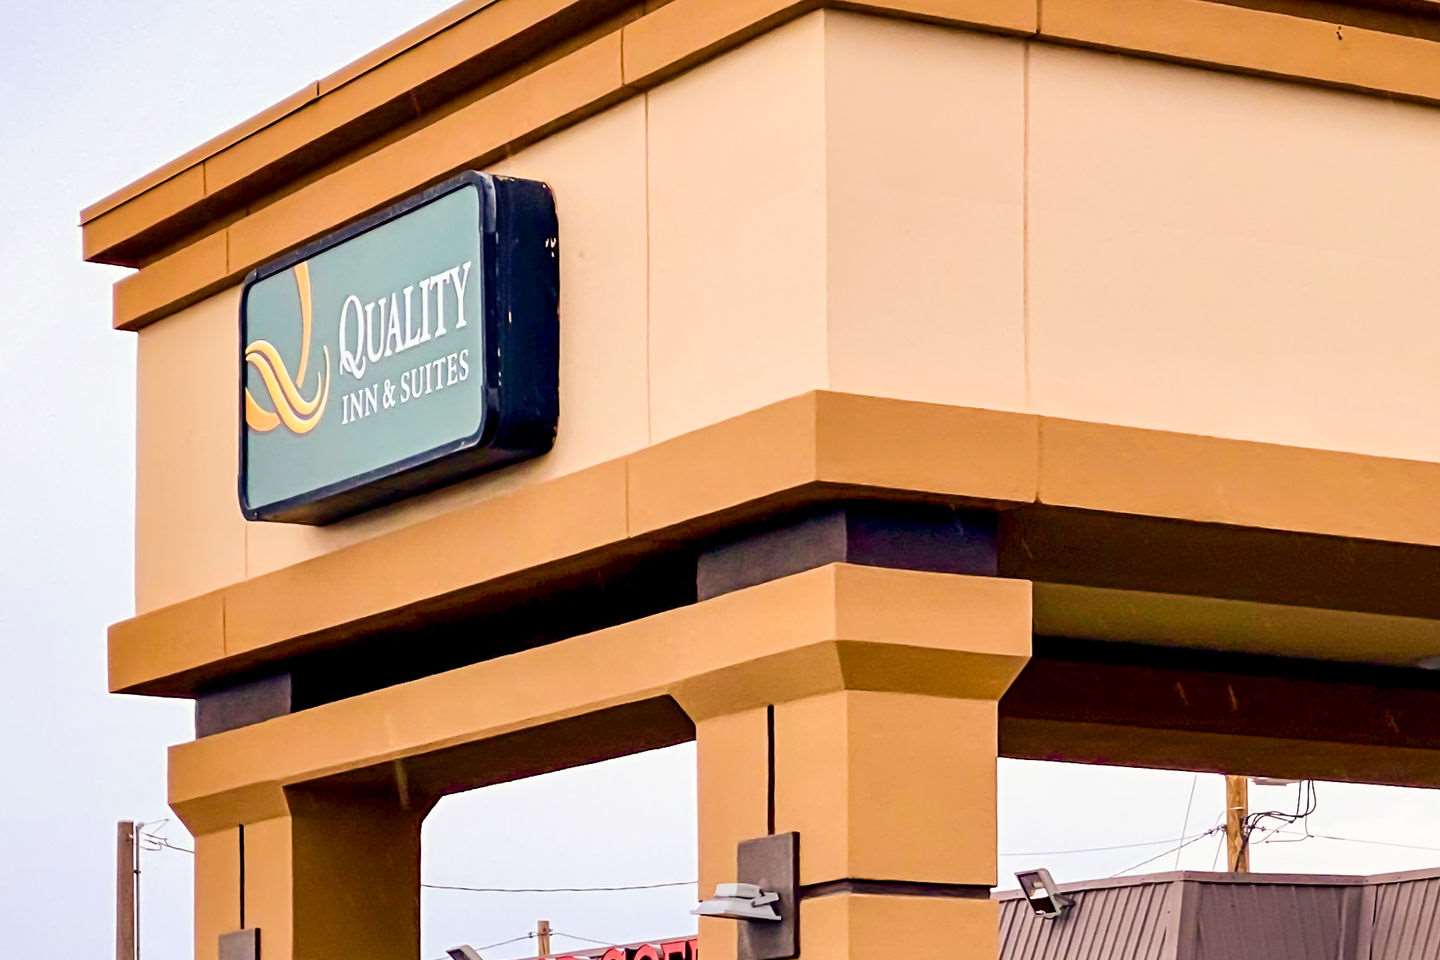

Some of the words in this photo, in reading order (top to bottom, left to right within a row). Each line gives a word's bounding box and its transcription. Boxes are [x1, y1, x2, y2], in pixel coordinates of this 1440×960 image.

[339, 261, 471, 379] QUALITY
[341, 384, 378, 425] INN
[382, 379, 396, 409] &
[400, 350, 470, 403] SUITES
